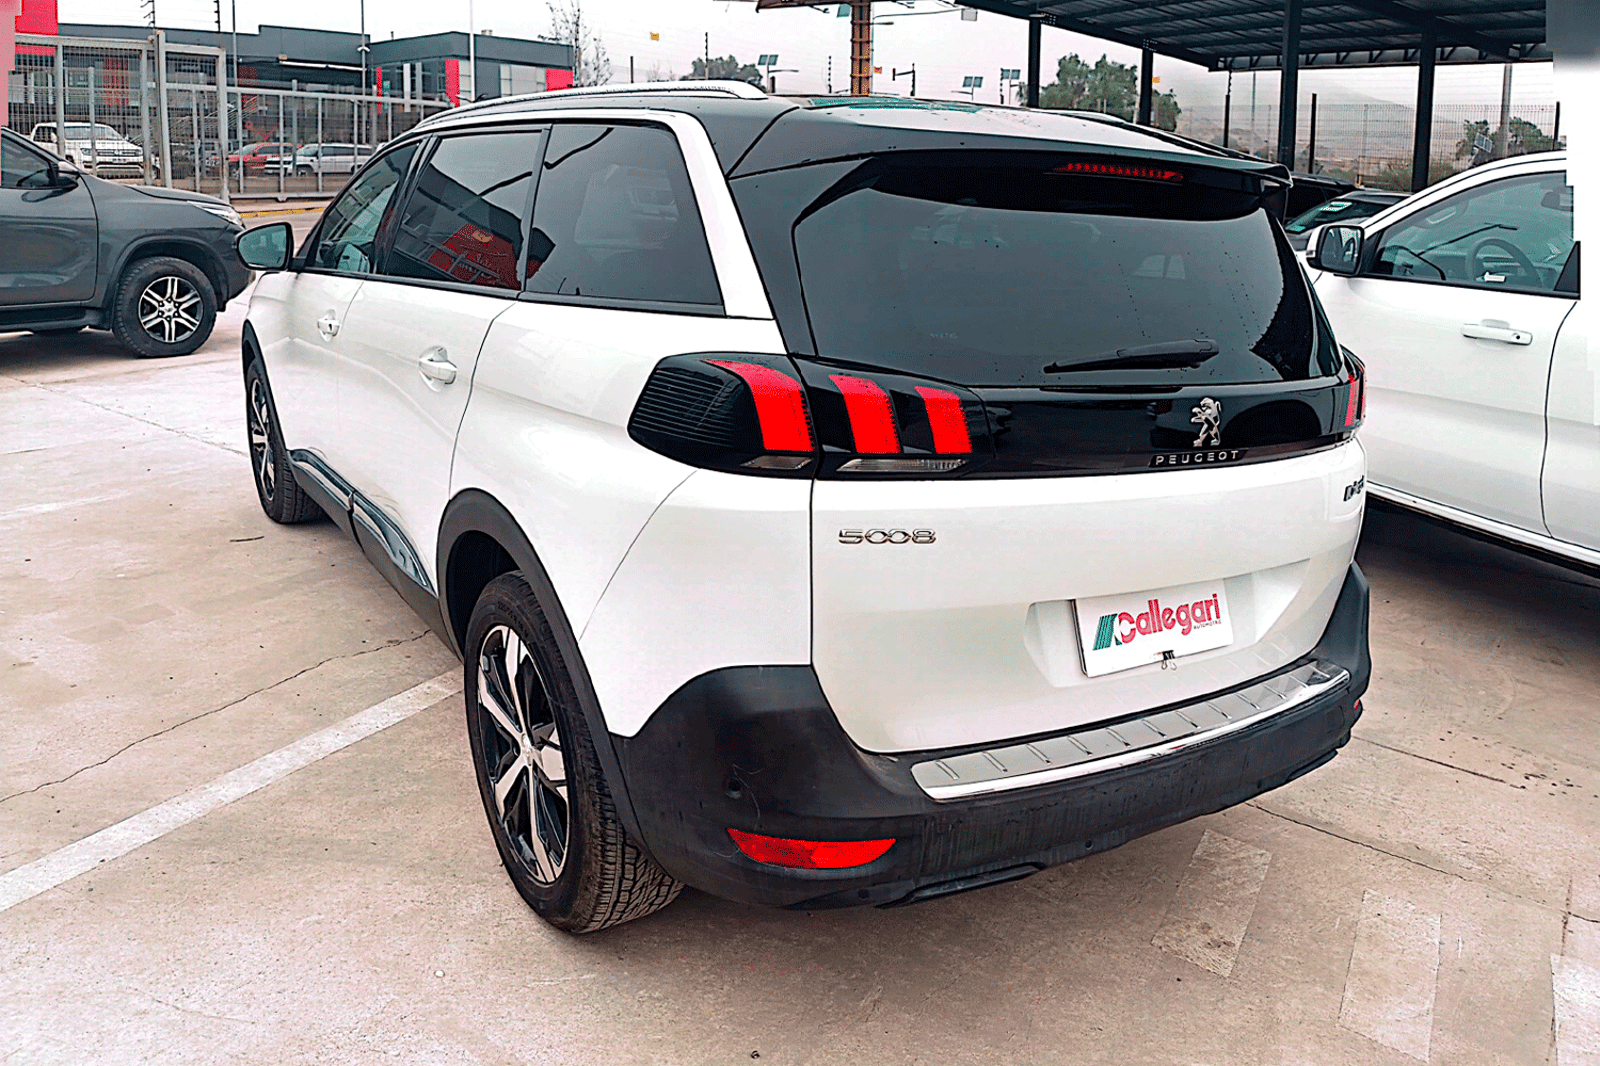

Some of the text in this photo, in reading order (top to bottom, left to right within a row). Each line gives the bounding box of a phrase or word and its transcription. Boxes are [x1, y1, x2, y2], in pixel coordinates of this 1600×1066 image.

[1155, 450, 1239, 466] PEUGEOT
[839, 529, 937, 544] 5008
[1117, 593, 1221, 644] Callegari
